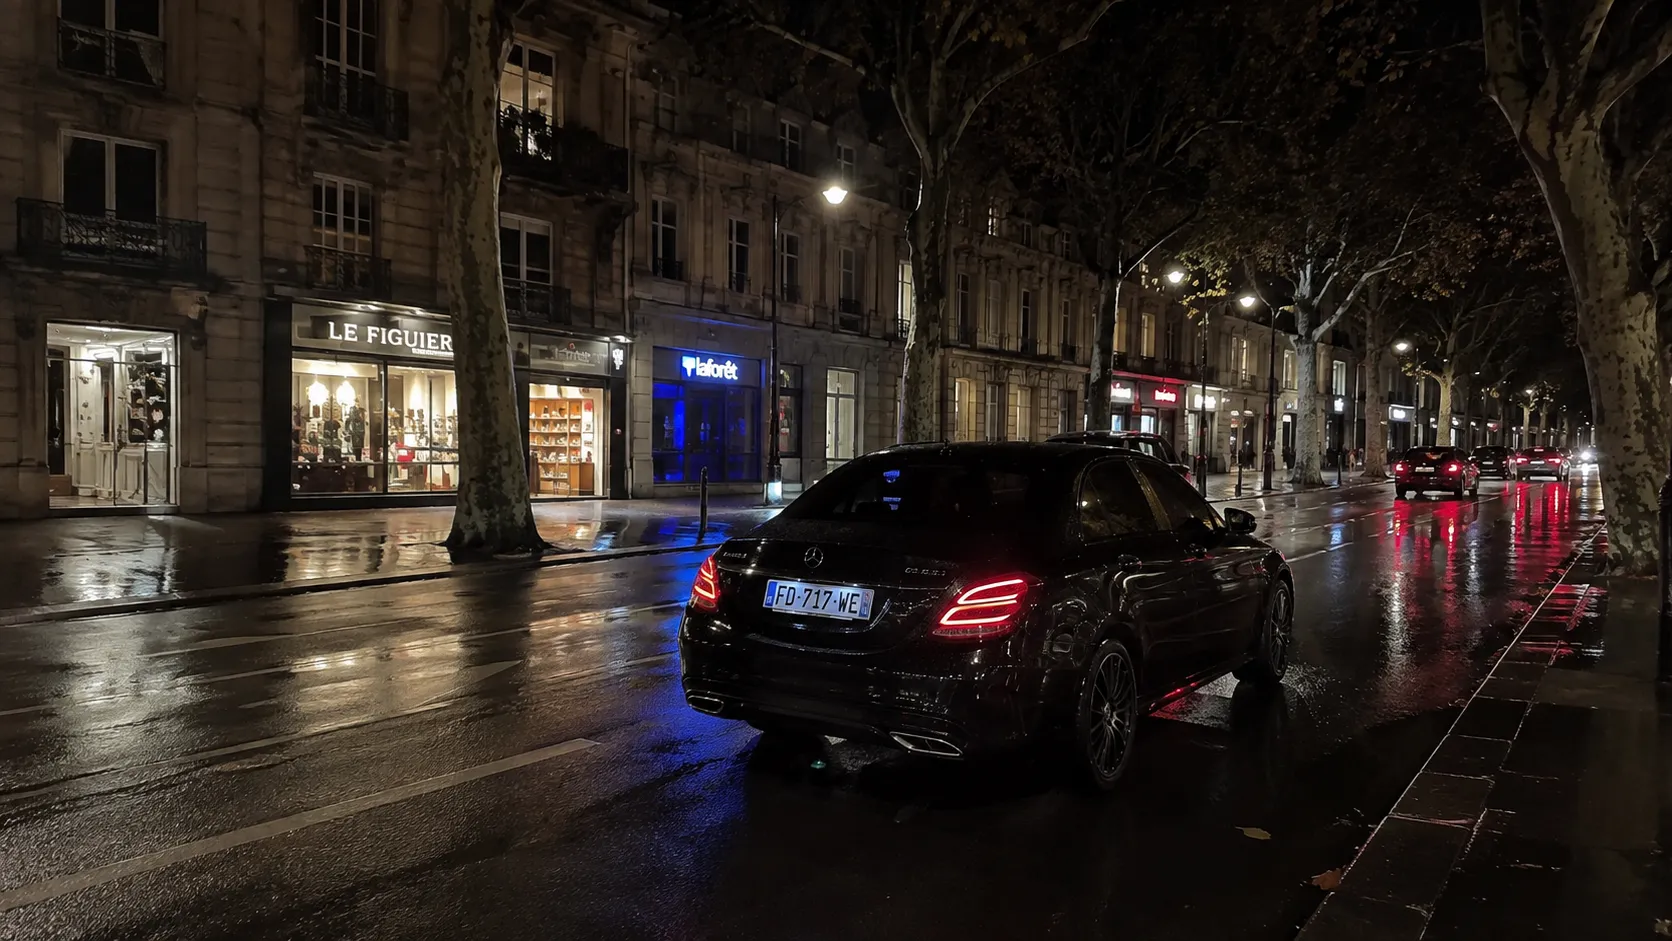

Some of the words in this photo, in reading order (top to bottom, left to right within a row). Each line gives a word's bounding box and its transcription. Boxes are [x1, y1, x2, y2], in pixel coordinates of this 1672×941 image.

[328, 321, 358, 342] LE
[366, 325, 453, 351] FIGUIER
[695, 356, 738, 380] laforêt
